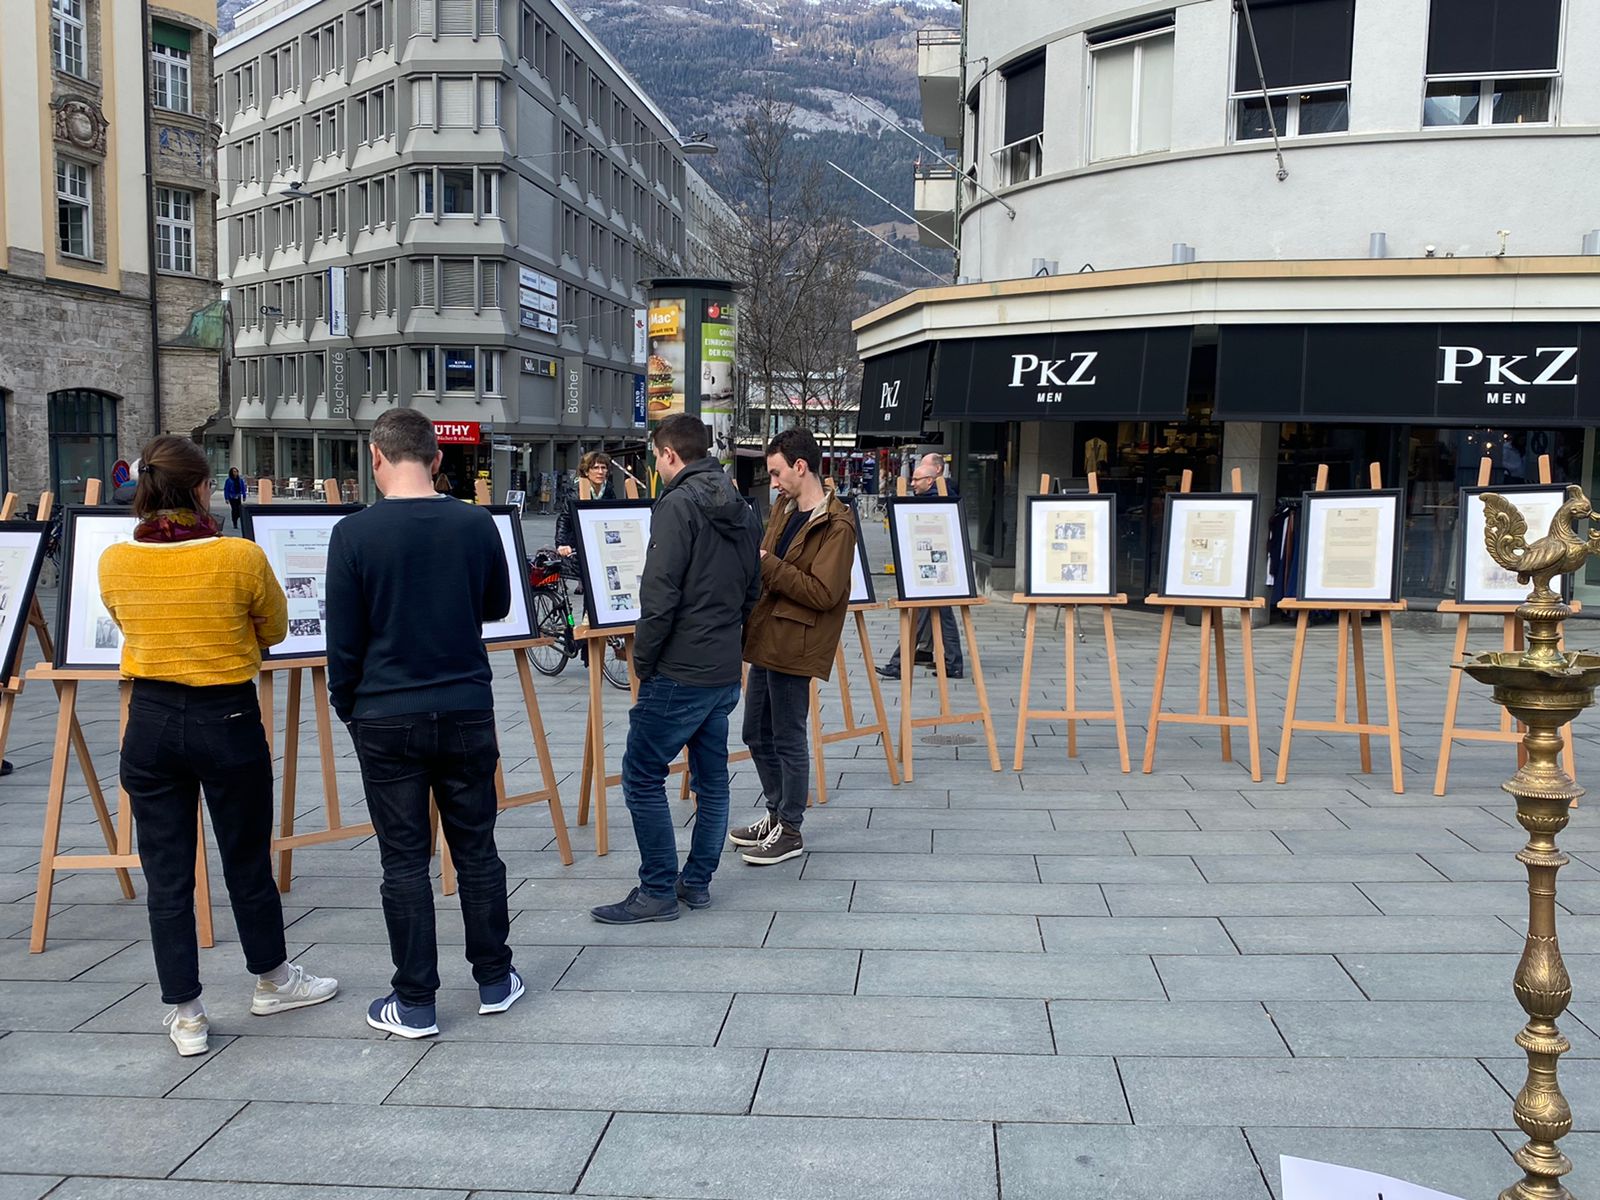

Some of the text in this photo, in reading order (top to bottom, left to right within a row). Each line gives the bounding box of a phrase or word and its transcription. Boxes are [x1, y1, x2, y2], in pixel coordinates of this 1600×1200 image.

[1008, 351, 1098, 387] PKZ
[1437, 346, 1578, 385] PKZ
[332, 352, 344, 414] Buchcafé
[567, 368, 579, 413] Bücher
[880, 379, 901, 409] PKZ
[1036, 392, 1062, 403] MEN
[1486, 392, 1526, 404] MEN
[434, 424, 472, 437] ÜTHY
